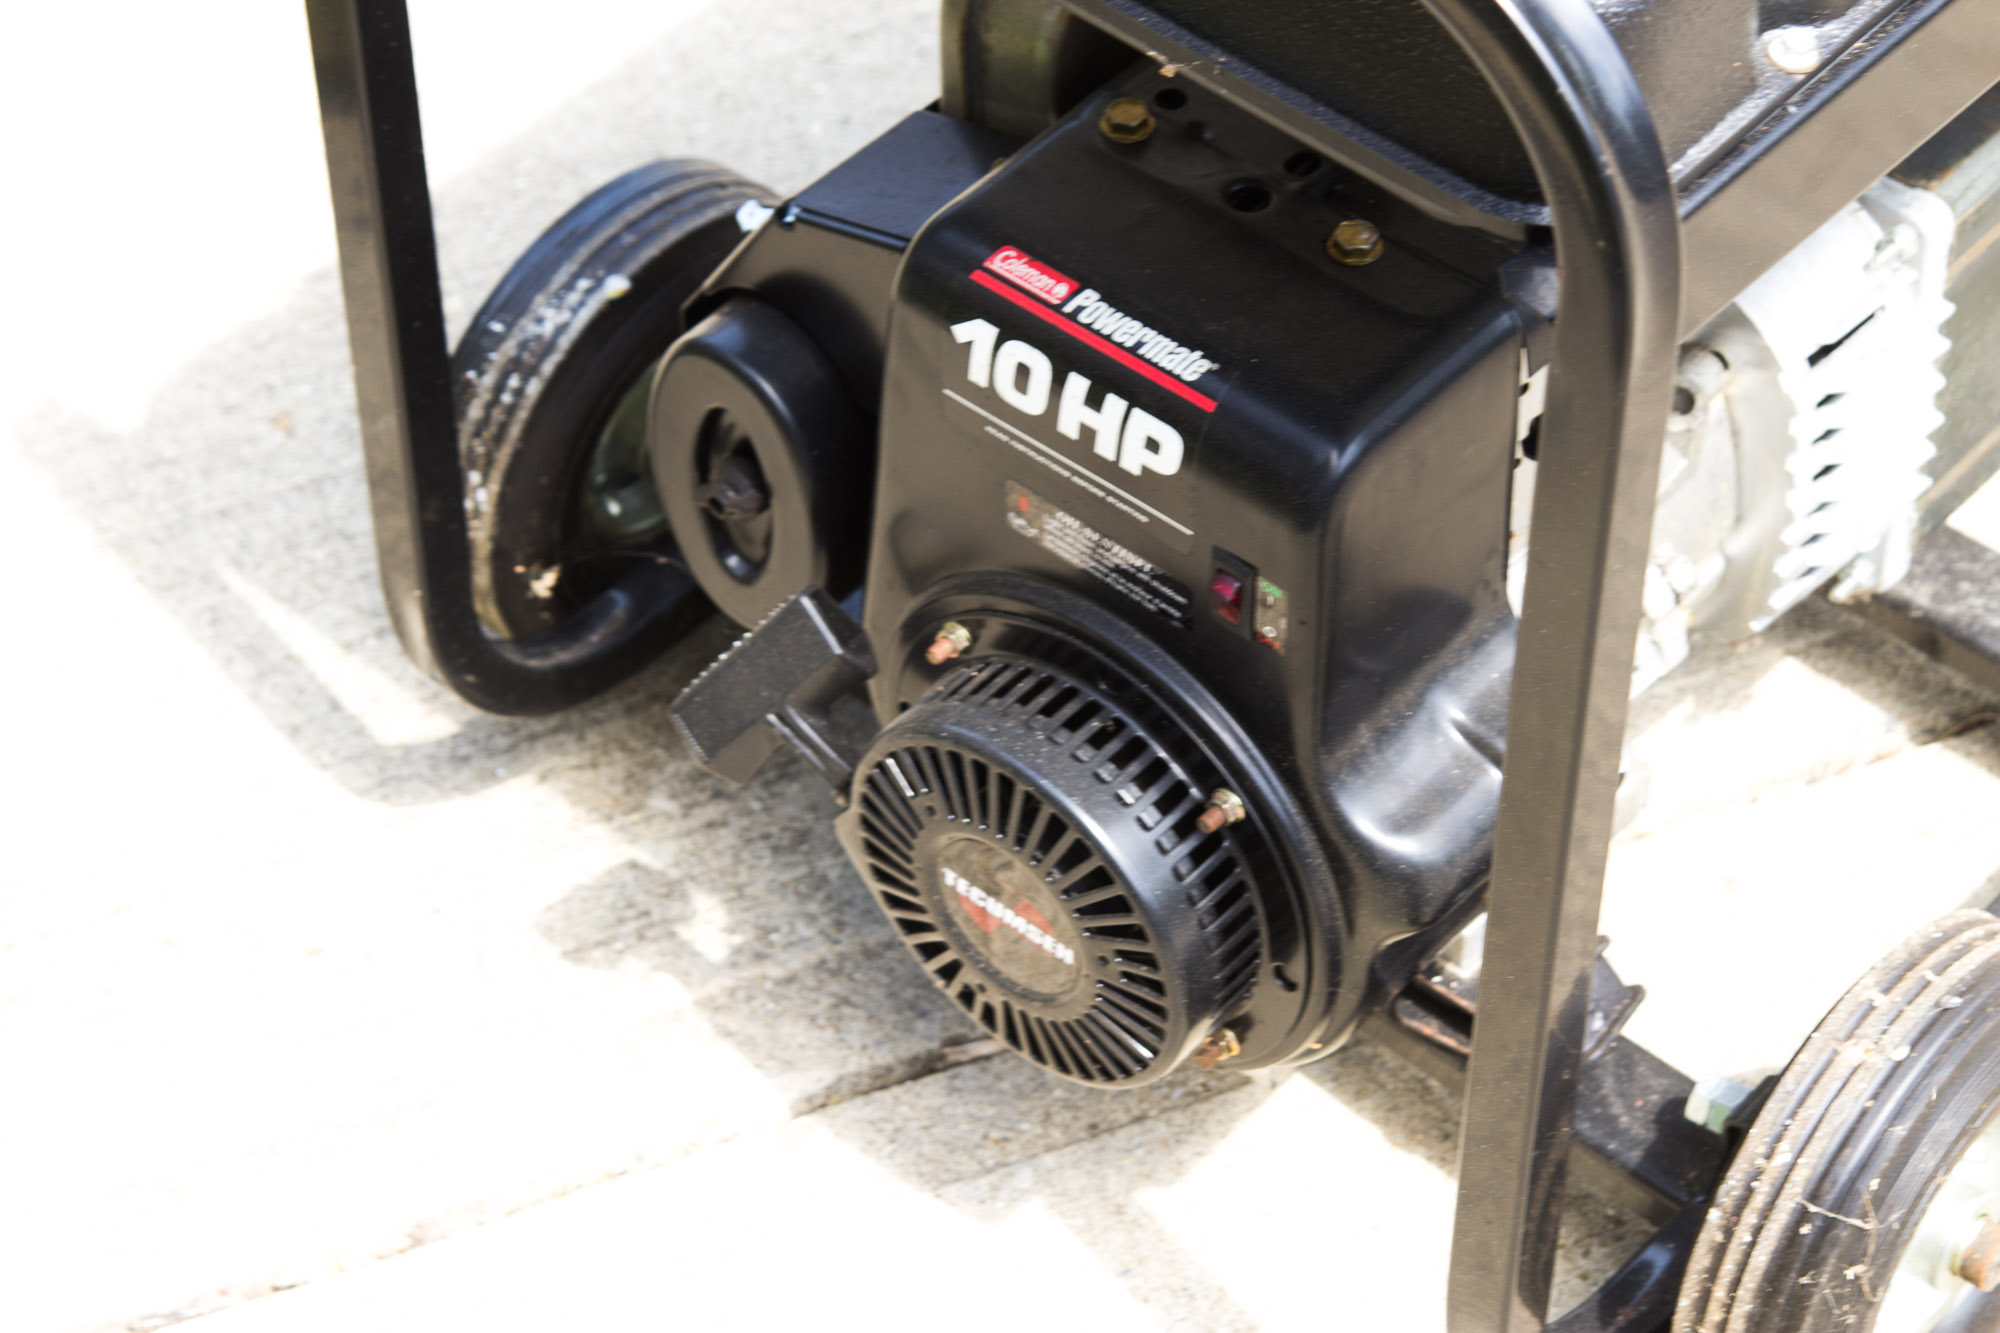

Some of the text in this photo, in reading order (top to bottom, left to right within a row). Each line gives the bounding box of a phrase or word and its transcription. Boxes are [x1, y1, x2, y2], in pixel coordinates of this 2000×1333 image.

[992, 249, 1057, 292] Coleman
[1061, 288, 1213, 383] Powermate
[949, 317, 1054, 417] 10
[1055, 370, 1185, 477] HP
[940, 866, 1076, 966] TECUMSEH
